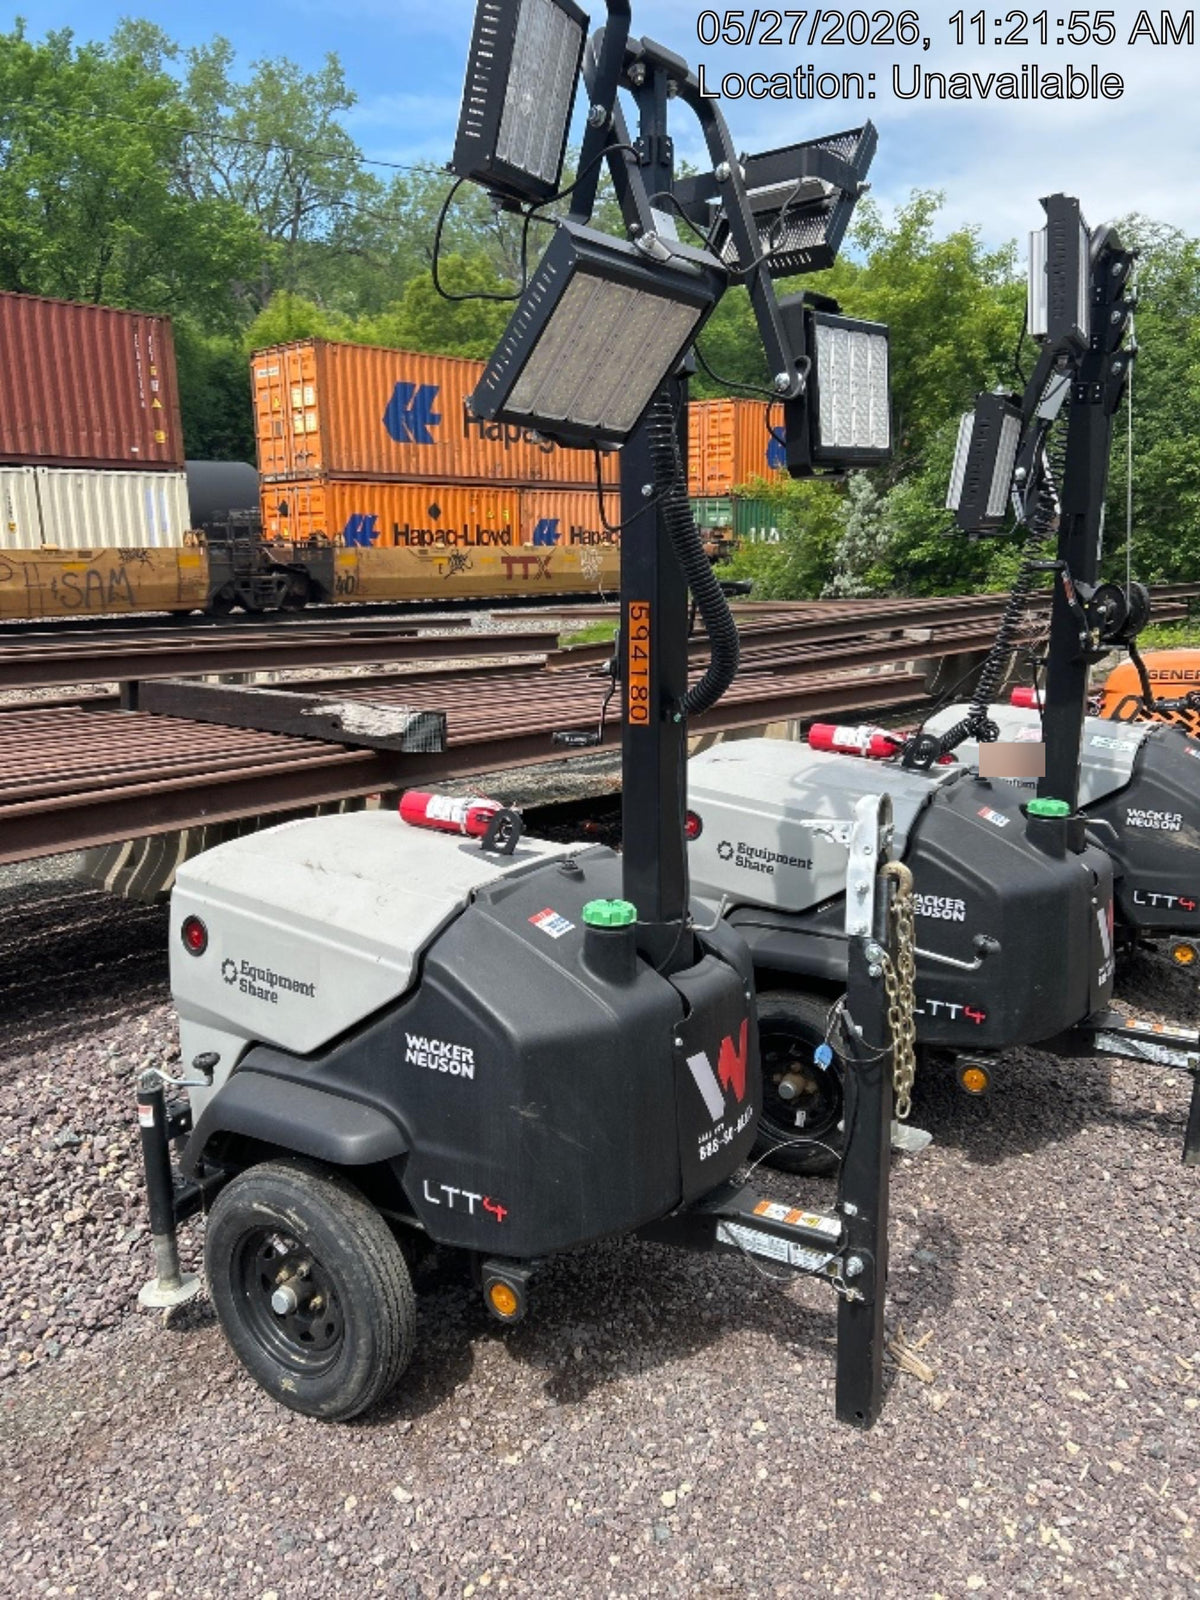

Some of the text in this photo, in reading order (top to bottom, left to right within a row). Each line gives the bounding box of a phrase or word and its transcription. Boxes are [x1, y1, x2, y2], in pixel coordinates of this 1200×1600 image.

[463, 401, 555, 454] Hap
[501, 556, 552, 580] TTX
[61, 567, 135, 609] SAM
[630, 605, 650, 721] 594180
[1126, 808, 1183, 823] WACKER
[1126, 817, 1181, 831] NEUSON
[735, 855, 775, 875] Share
[737, 841, 813, 870] Equipment
[913, 893, 966, 911] ACKER
[913, 903, 966, 922] EUSON
[1133, 889, 1196, 911] LTT4
[239, 978, 279, 1004] Share
[240, 959, 316, 998] Equipment
[405, 1032, 475, 1064] WACKER
[405, 1048, 475, 1080] NEUSON
[423, 1179, 508, 1223] LTT4
